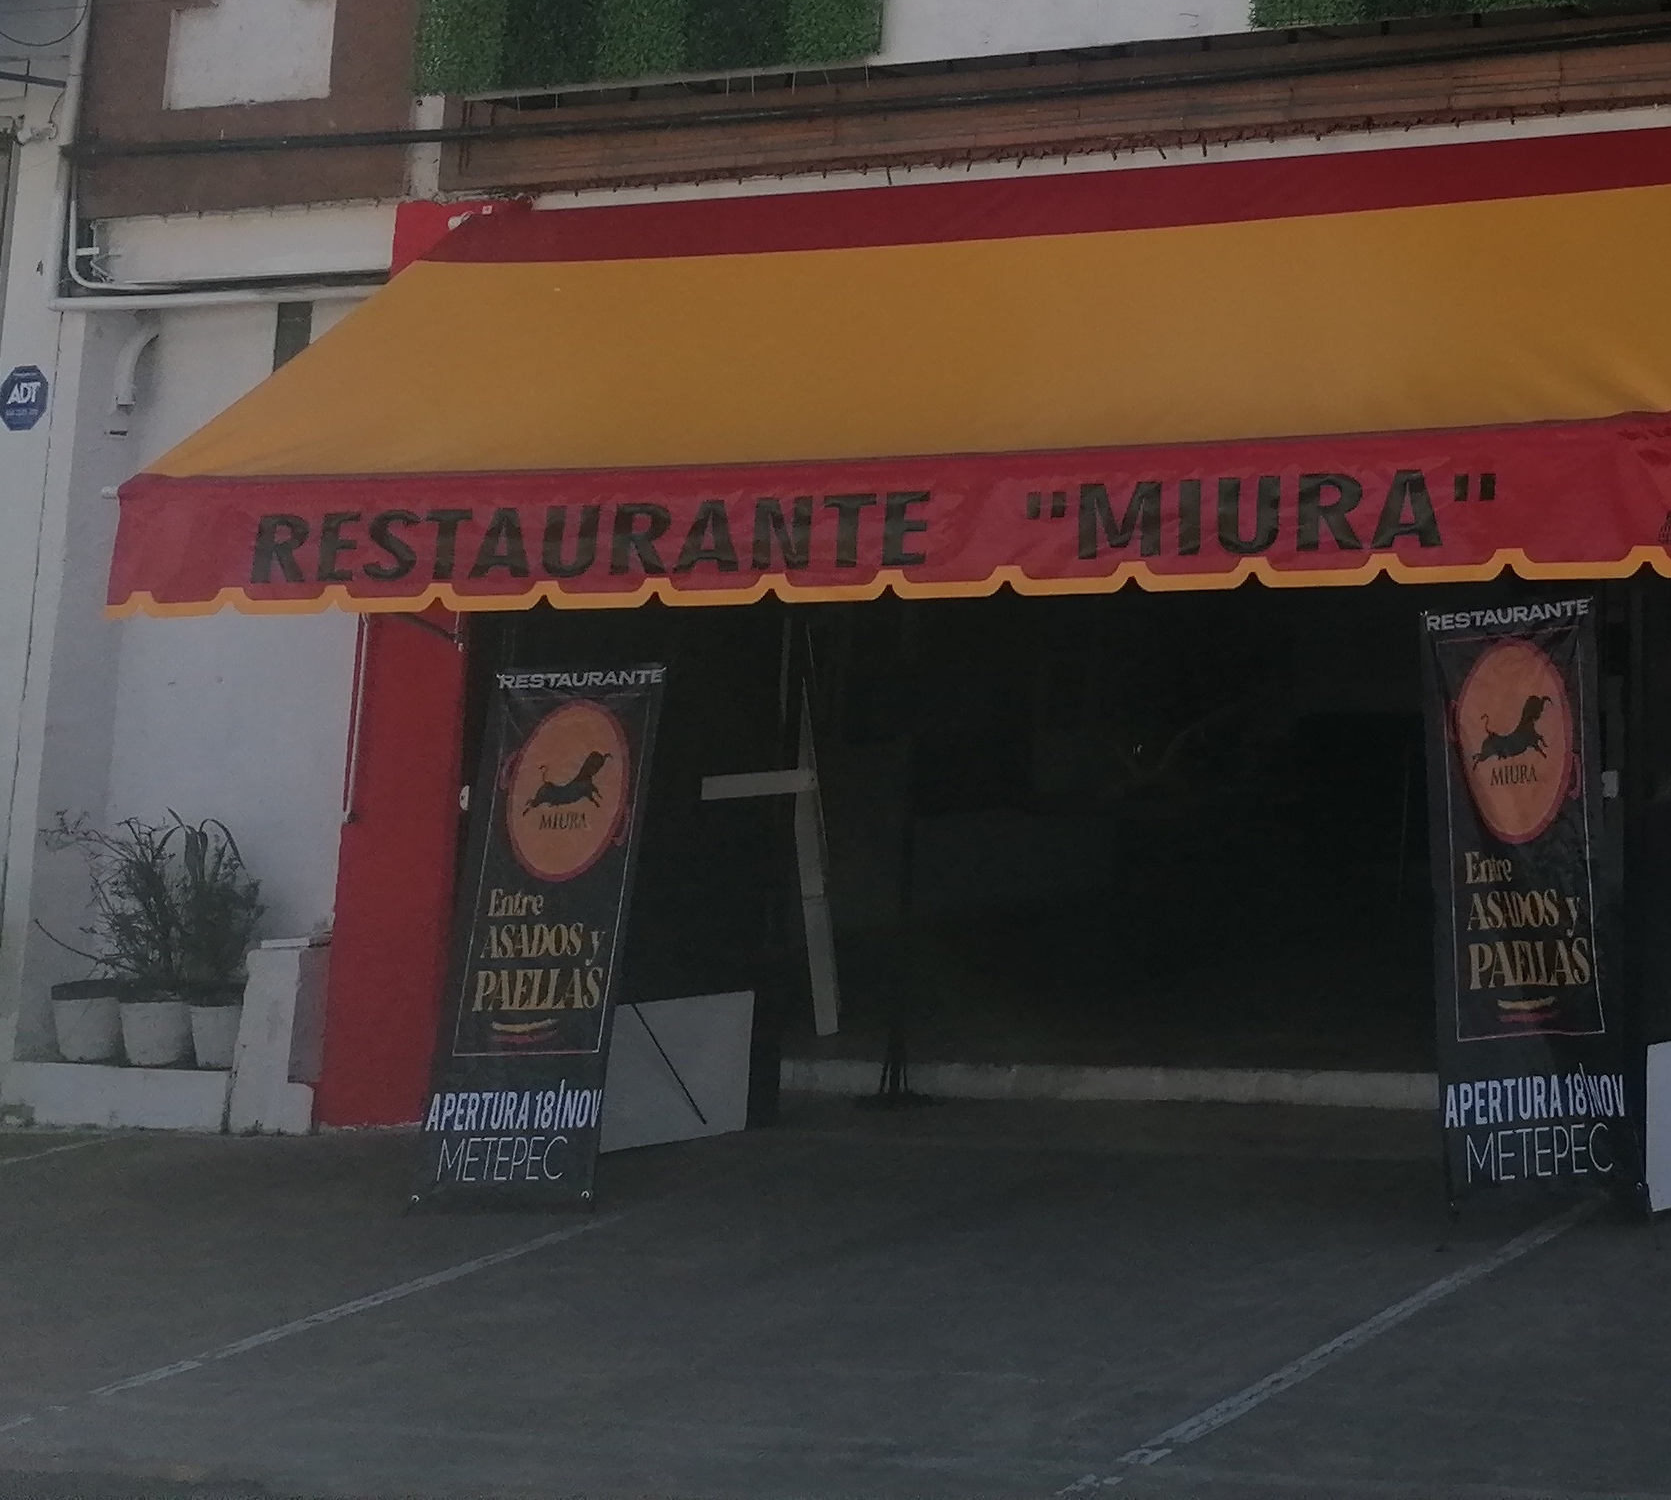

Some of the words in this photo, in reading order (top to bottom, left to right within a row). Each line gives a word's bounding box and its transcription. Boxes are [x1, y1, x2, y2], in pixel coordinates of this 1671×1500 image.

[6, 382, 42, 405] ADT
[250, 490, 932, 584] RESTAURANTE
[1026, 468, 1496, 560] "MIURA"
[1425, 600, 1590, 631] RESTAURANTE
[498, 669, 664, 689] RESTAURANTE
[1490, 764, 1537, 786] MIURA
[539, 811, 587, 831] MIURA
[1464, 851, 1512, 884] Entre
[487, 888, 544, 917] Entre
[1466, 888, 1559, 931] ASADOS
[480, 922, 584, 958] ASADOS
[1468, 937, 1590, 990] PAELLAS
[472, 966, 603, 1012] PAELLAS
[425, 1091, 529, 1131] APERTURA
[1444, 1074, 1563, 1129] APERTURA
[436, 1135, 569, 1182] METEPEC
[1466, 1122, 1614, 1184] METEPEC
